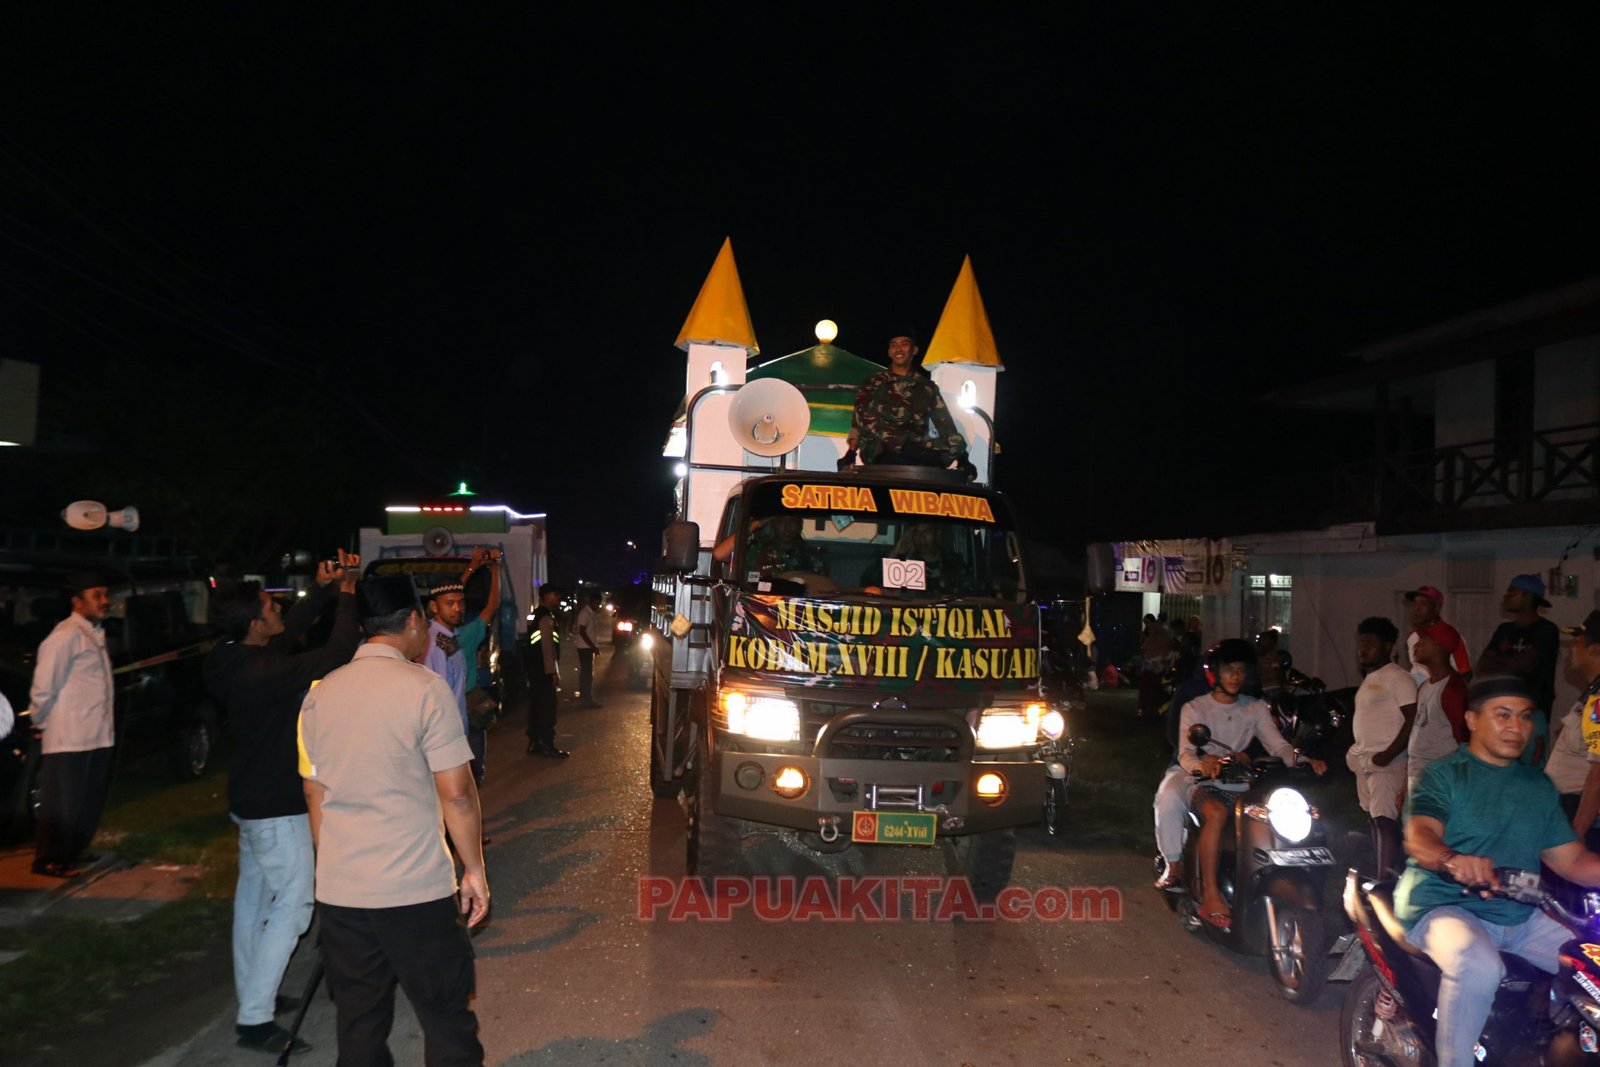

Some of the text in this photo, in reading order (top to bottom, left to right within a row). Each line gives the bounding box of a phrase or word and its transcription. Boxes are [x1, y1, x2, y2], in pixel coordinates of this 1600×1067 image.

[782, 484, 995, 522] SATRIA WIBAWA
[887, 562, 925, 588] 02
[775, 599, 1012, 639] MASJID ISTIQLAL
[729, 635, 828, 674] KODAM
[837, 643, 909, 678] XVIII
